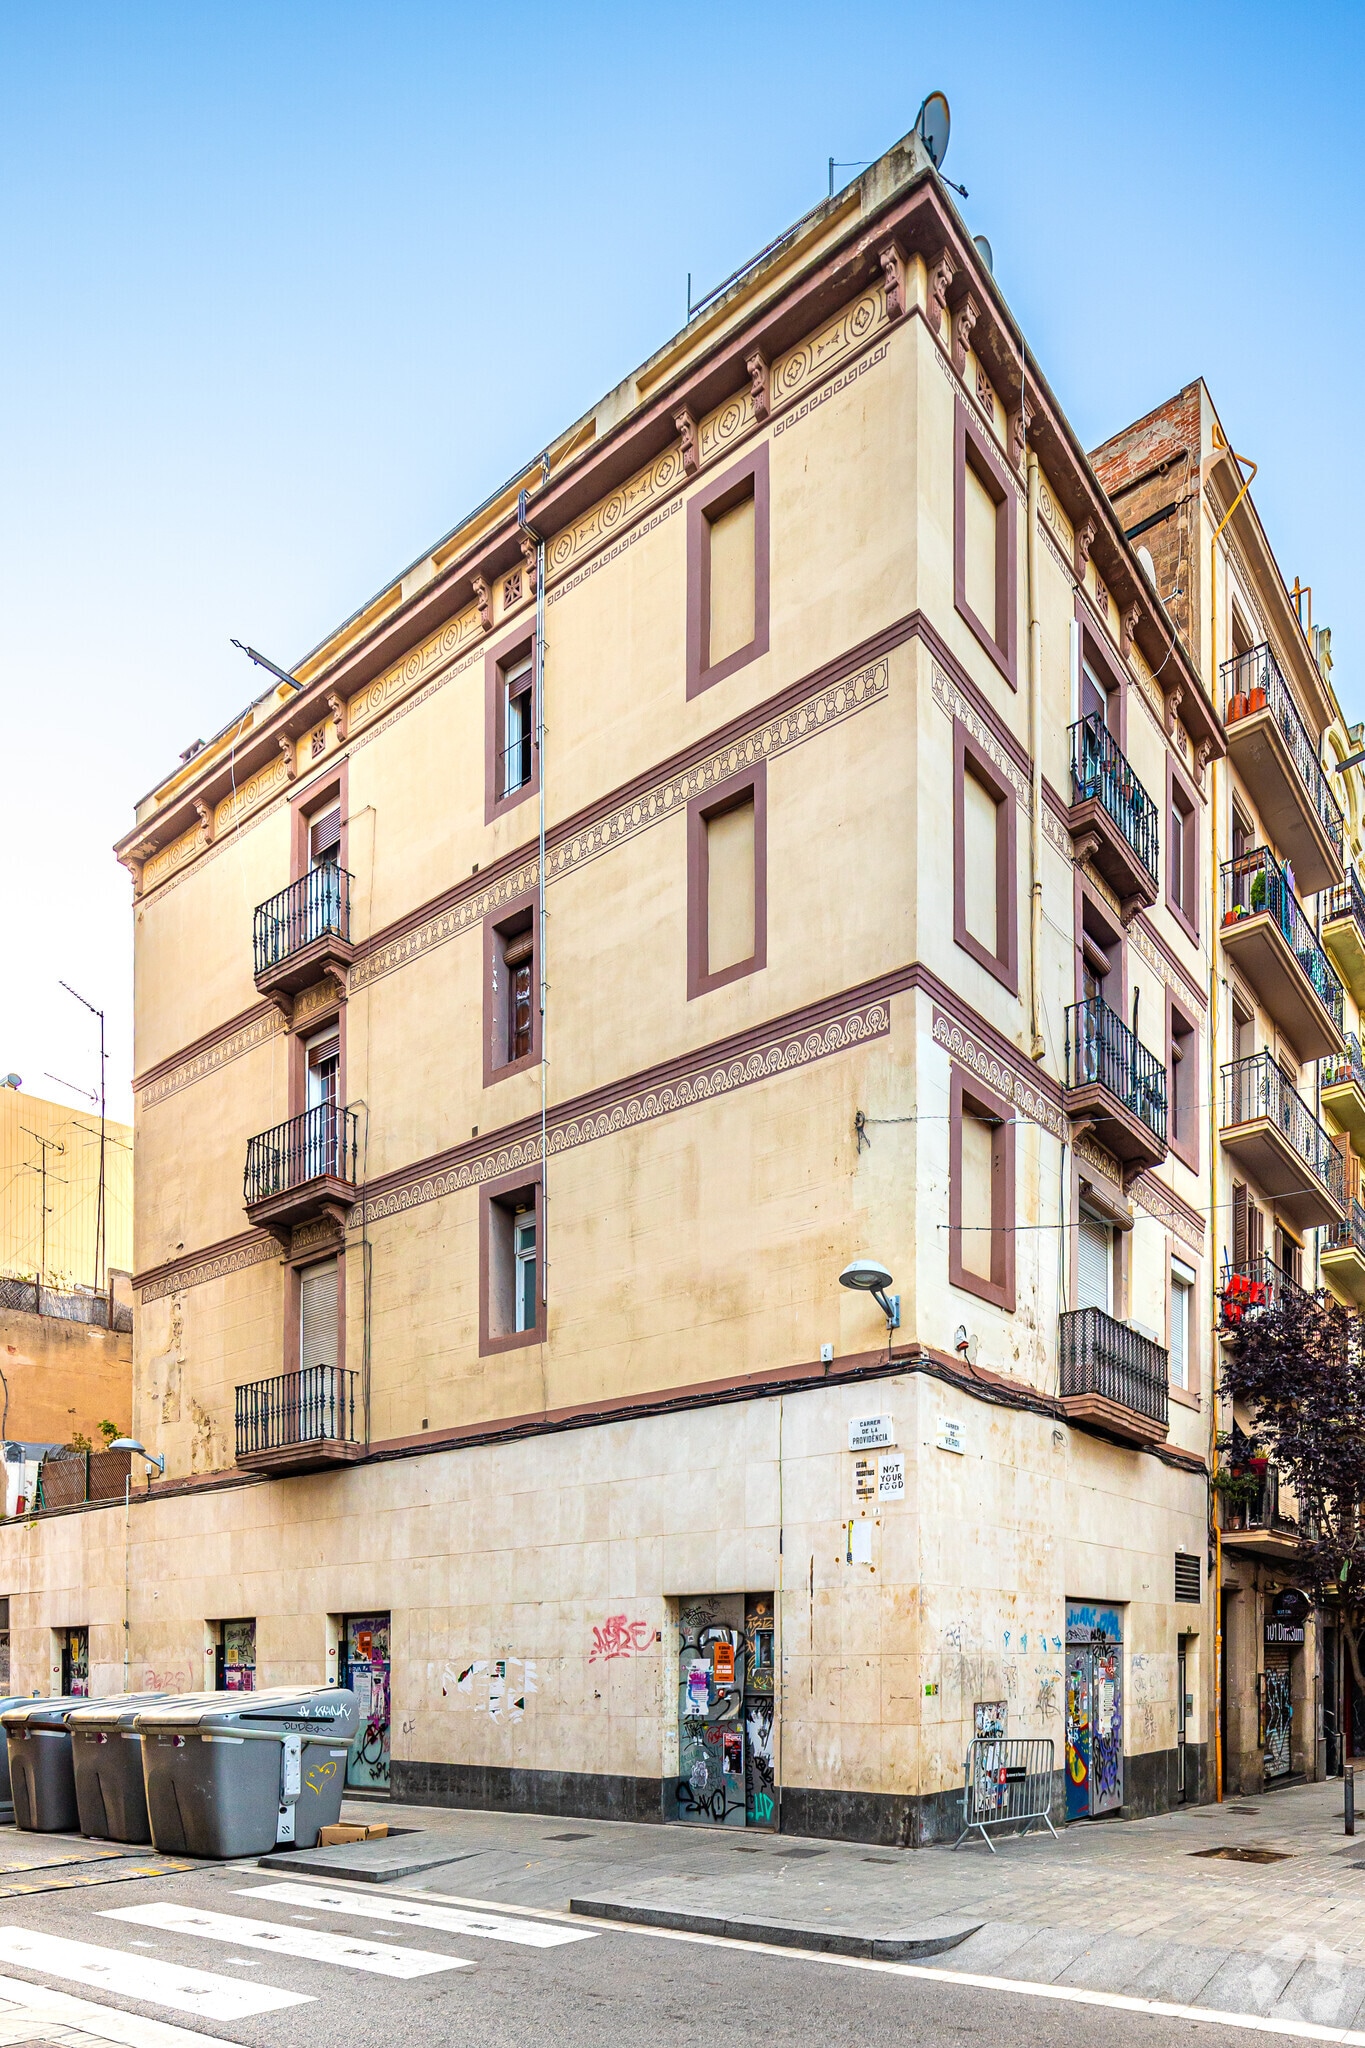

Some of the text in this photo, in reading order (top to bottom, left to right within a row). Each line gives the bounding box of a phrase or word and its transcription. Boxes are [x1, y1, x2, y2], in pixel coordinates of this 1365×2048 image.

[860, 1419, 881, 1428] CARRER
[945, 1422, 959, 1430] CARRER
[945, 1437, 960, 1447] VERDI
[883, 1464, 900, 1474] NOT
[881, 1472, 902, 1483] YOUR
[879, 1480, 904, 1491] FOOD
[1266, 1622, 1277, 1641] 101
